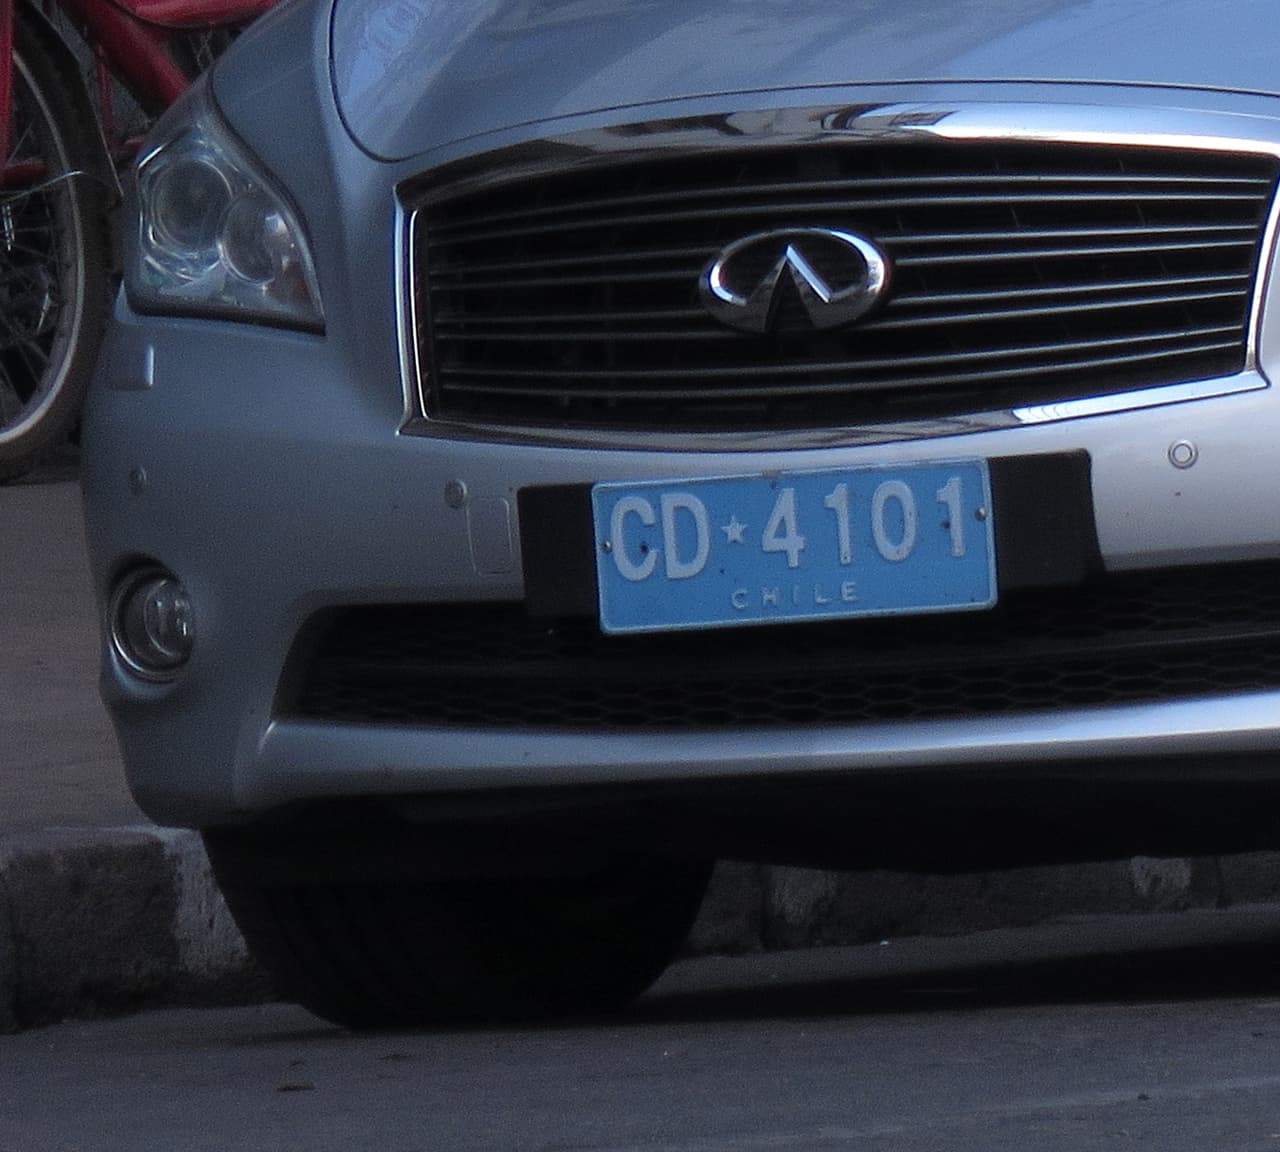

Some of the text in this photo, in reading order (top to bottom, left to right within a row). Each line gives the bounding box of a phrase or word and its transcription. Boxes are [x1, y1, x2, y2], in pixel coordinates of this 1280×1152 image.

[610, 476, 967, 582] CD 4101
[730, 581, 860, 610] CHILE
